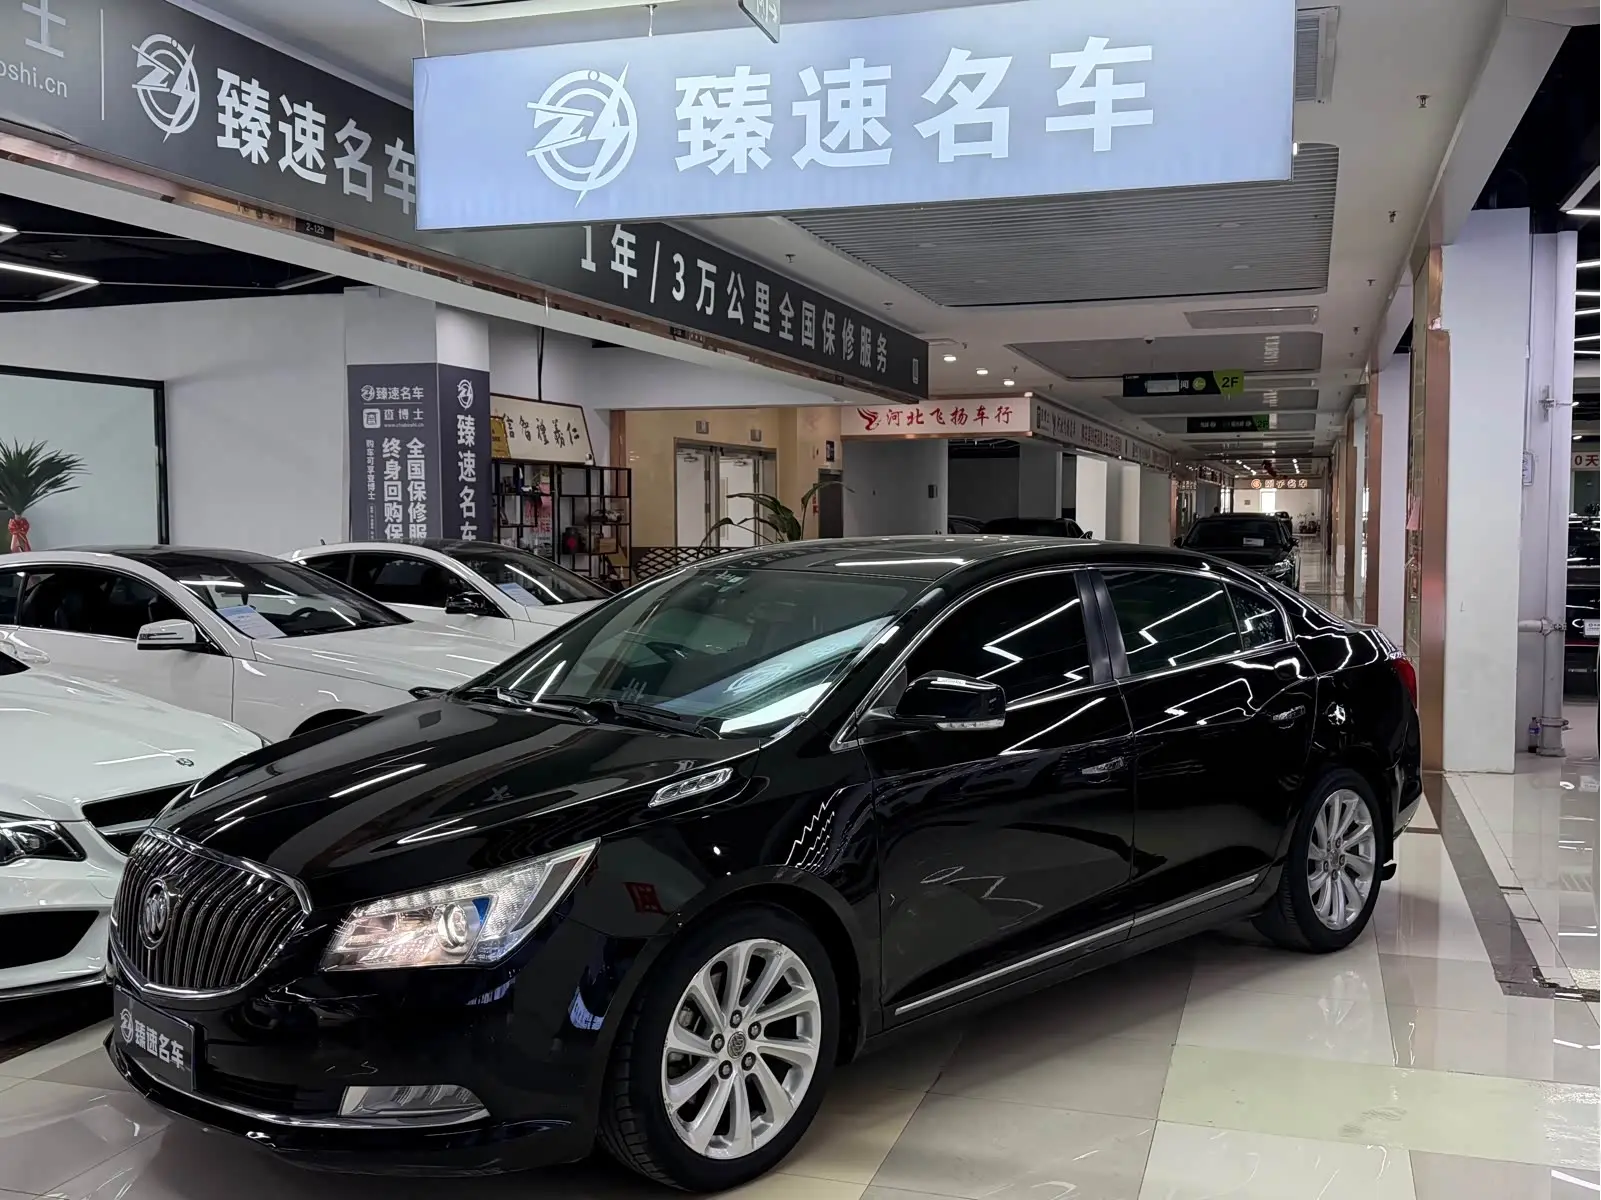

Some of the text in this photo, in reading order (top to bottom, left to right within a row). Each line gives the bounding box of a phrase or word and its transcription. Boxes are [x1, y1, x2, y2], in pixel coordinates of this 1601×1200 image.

[22, 0, 66, 58] 士
[675, 36, 1155, 175] 臻速名车
[216, 67, 417, 215] 臻速名车
[375, 386, 425, 400] 臻速名车
[1221, 376, 1239, 388] 2F
[886, 404, 1013, 426] 河北飞扬车行
[135, 1019, 184, 1069] 臻速名车
